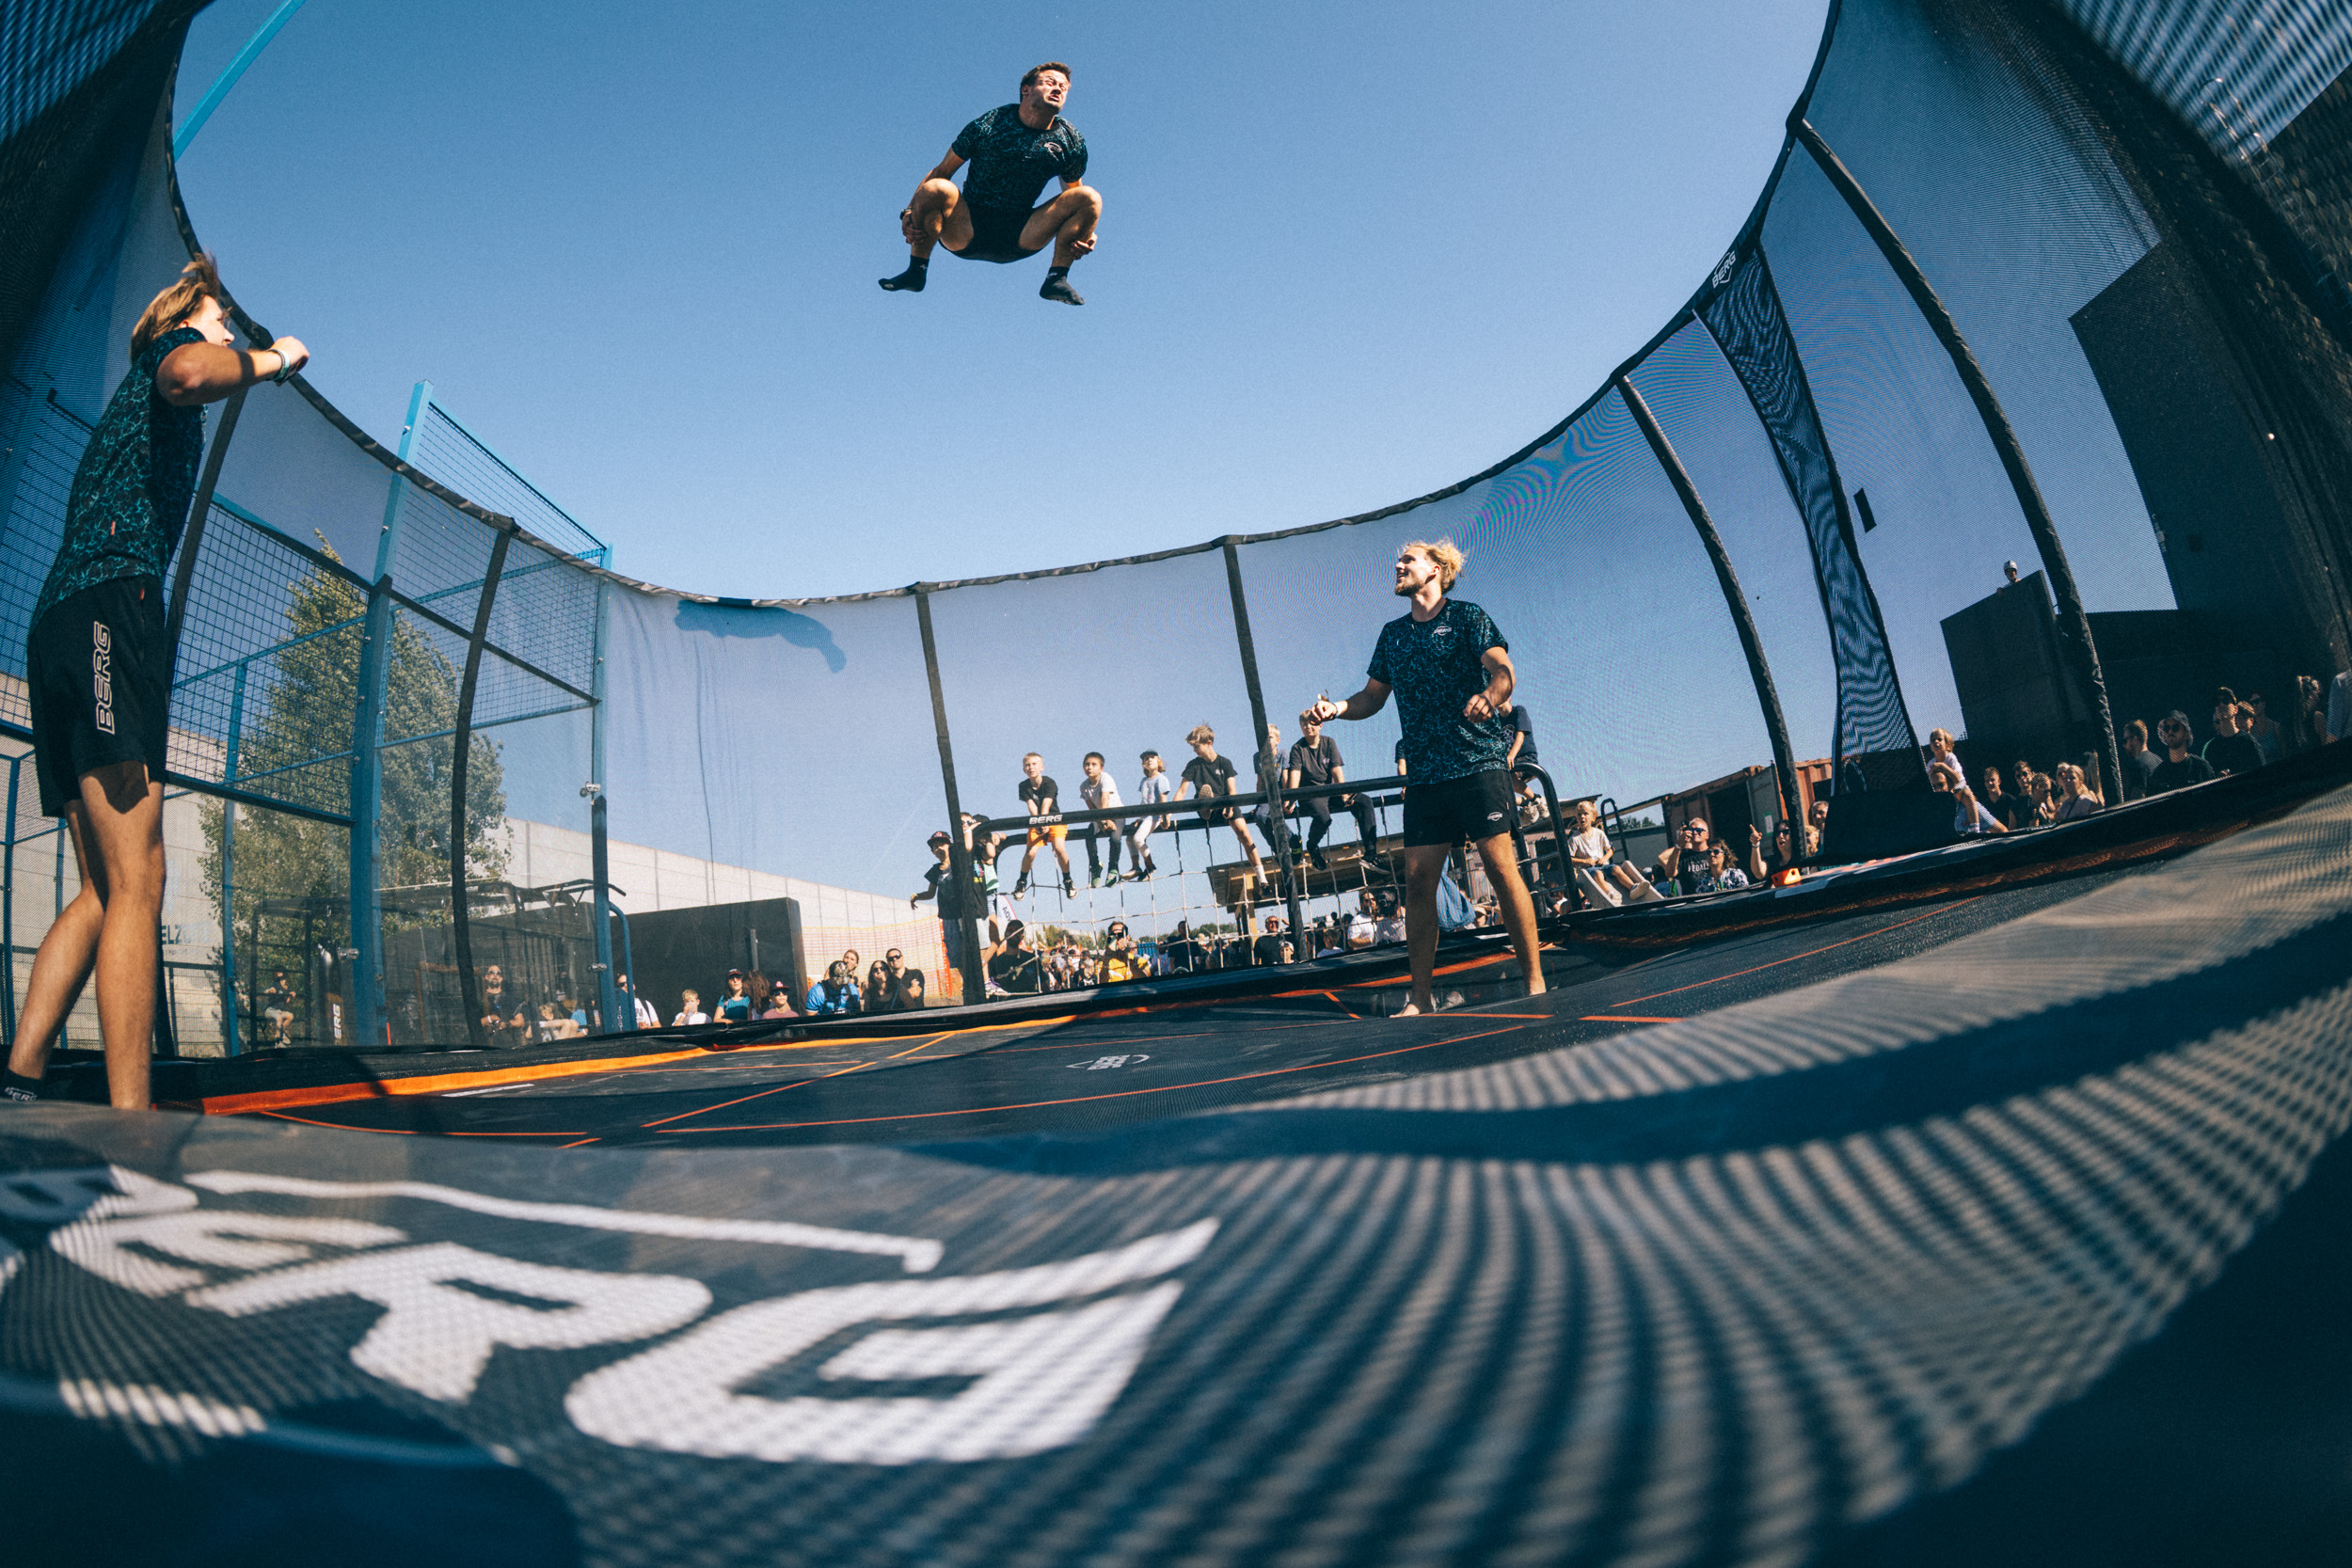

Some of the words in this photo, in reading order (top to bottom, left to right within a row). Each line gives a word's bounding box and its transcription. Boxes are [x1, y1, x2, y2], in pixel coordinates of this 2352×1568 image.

[1712, 250, 1736, 289] BERG
[93, 621, 115, 735] BERG
[1028, 814, 1063, 825] BERG
[332, 1003, 342, 1045] ERG
[0, 1164, 1221, 1466] BERG
